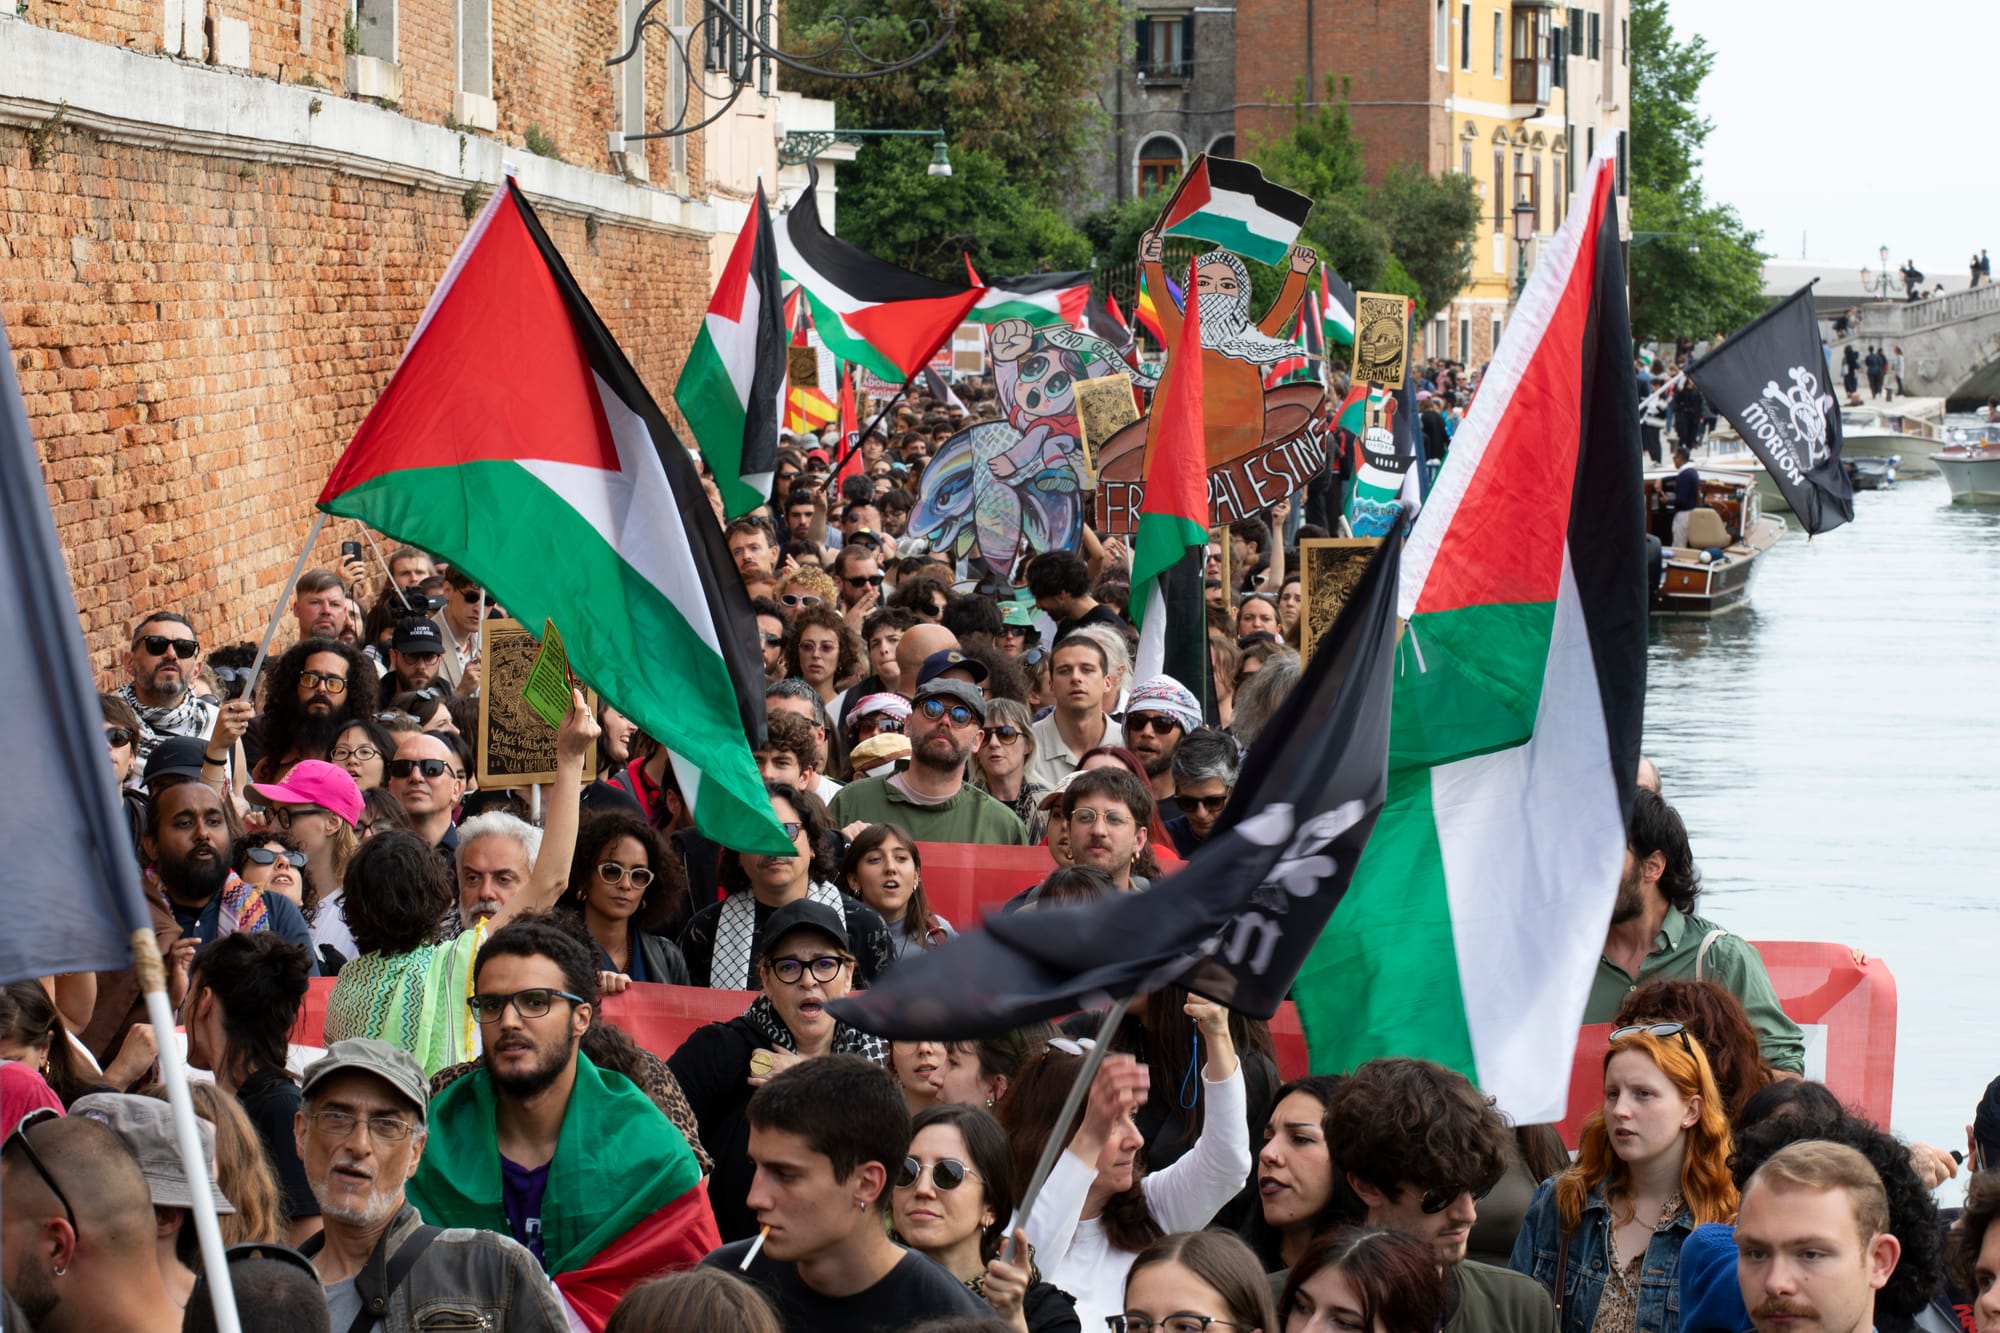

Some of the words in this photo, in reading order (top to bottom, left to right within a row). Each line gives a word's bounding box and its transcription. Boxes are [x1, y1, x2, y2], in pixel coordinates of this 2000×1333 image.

[1053, 330, 1084, 349] END
[1357, 365, 1400, 382] BIENNALE
[1741, 402, 1806, 486] MORION
[1106, 483, 1143, 533] FR
